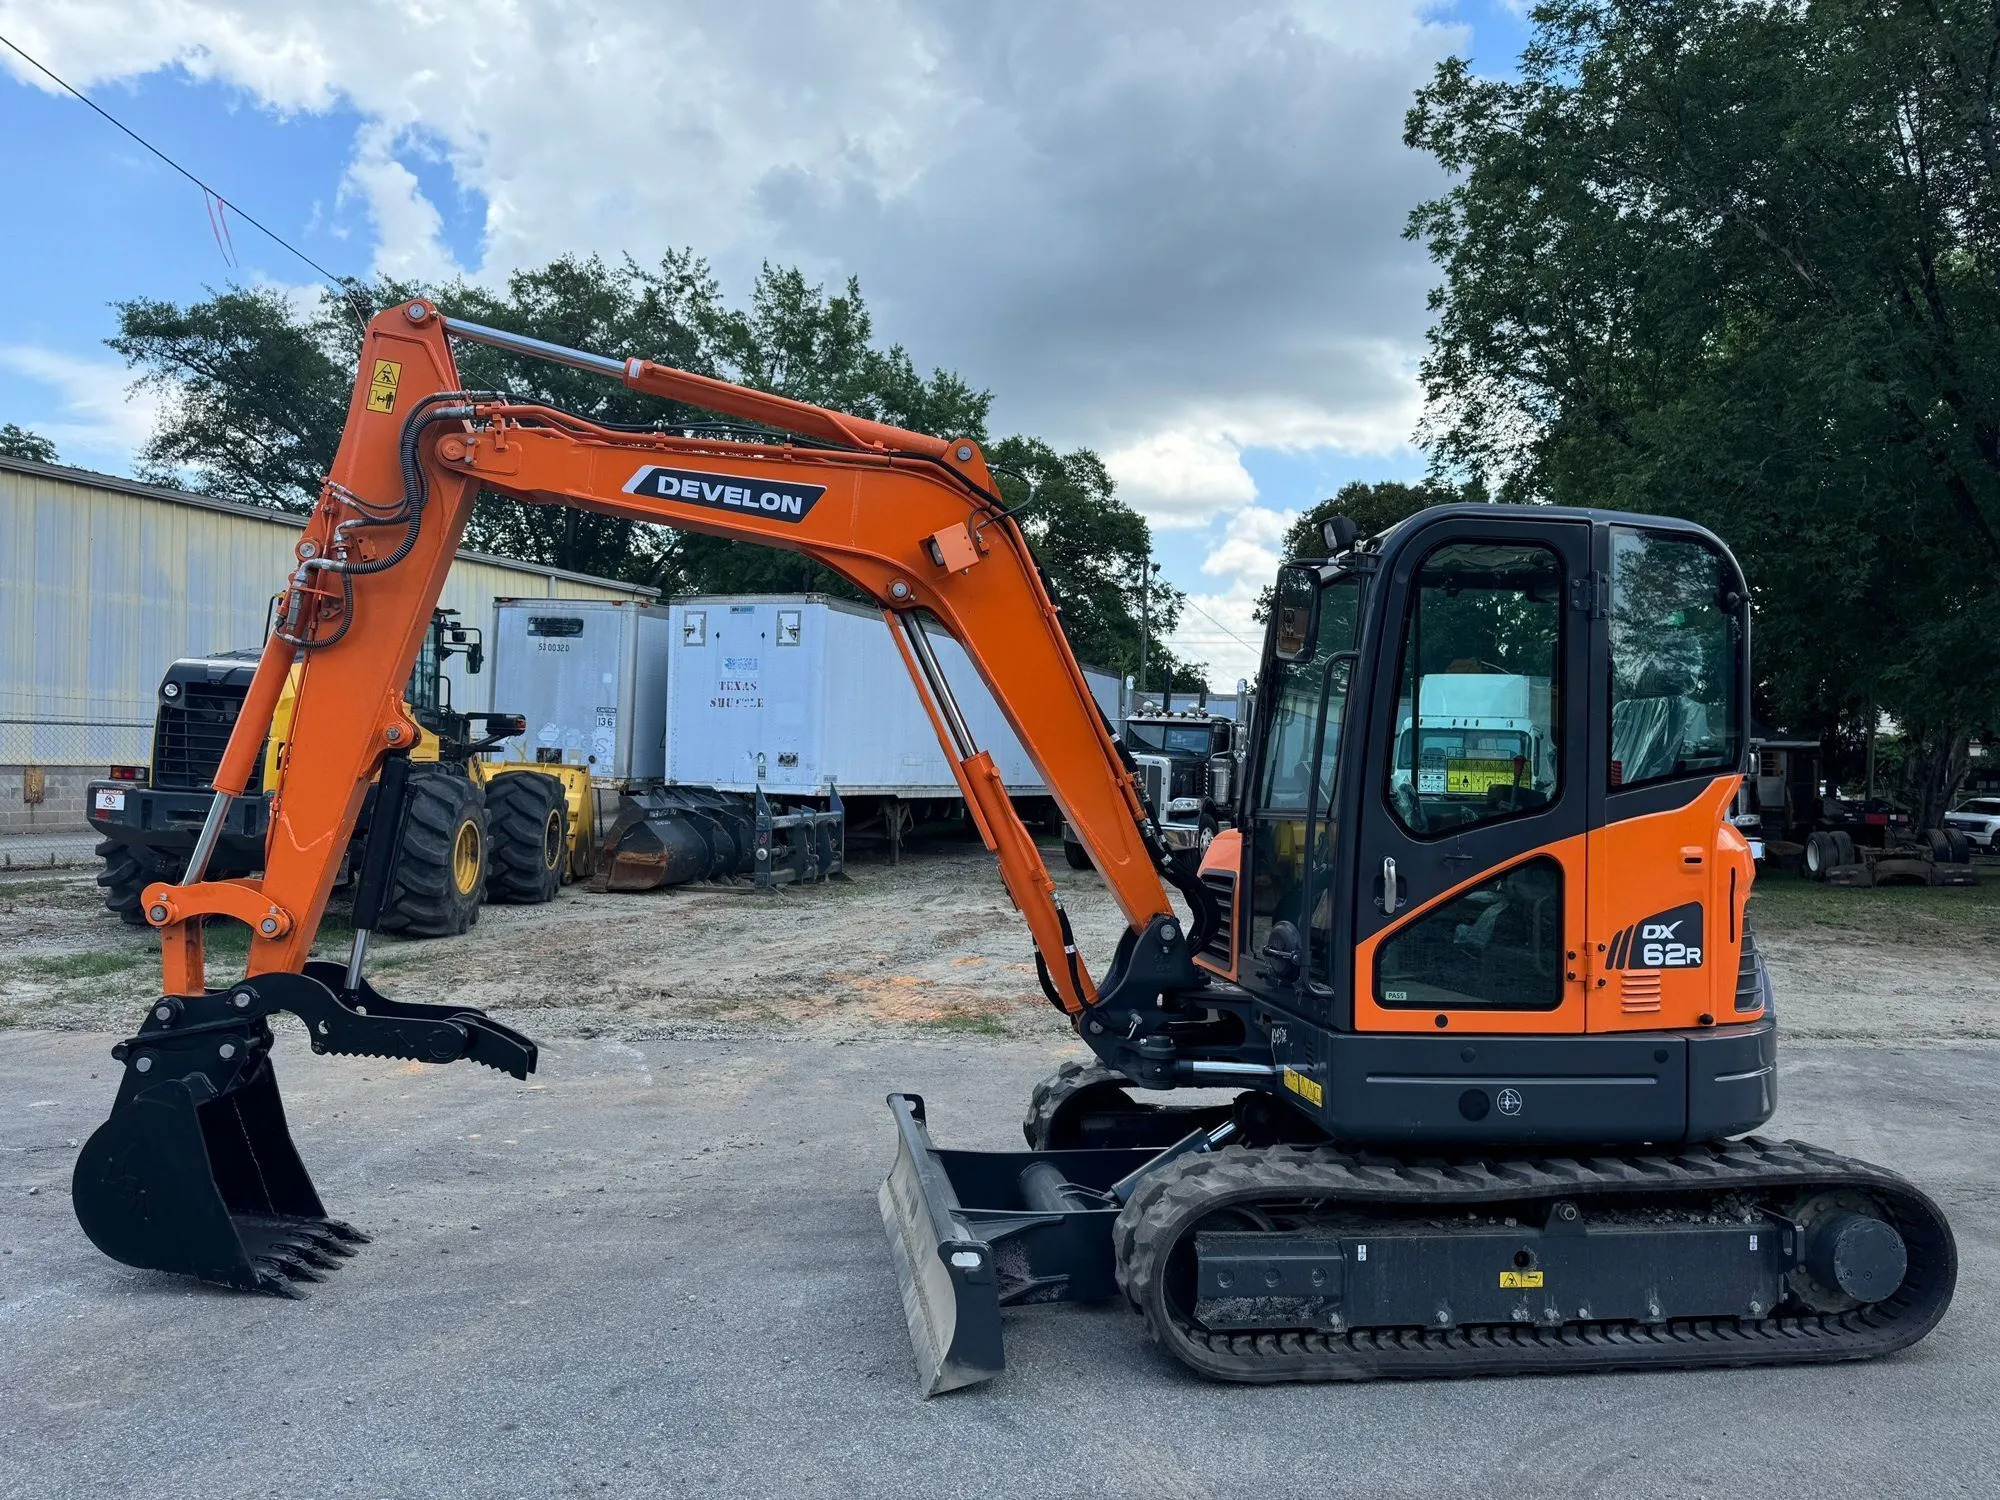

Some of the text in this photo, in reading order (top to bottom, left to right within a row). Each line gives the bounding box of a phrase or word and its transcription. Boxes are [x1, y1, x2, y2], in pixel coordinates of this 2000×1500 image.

[656, 475, 803, 515] DEVELON
[718, 681, 757, 691] TEXAS
[1641, 920, 1684, 939] DX
[1643, 943, 1702, 966] 62R
